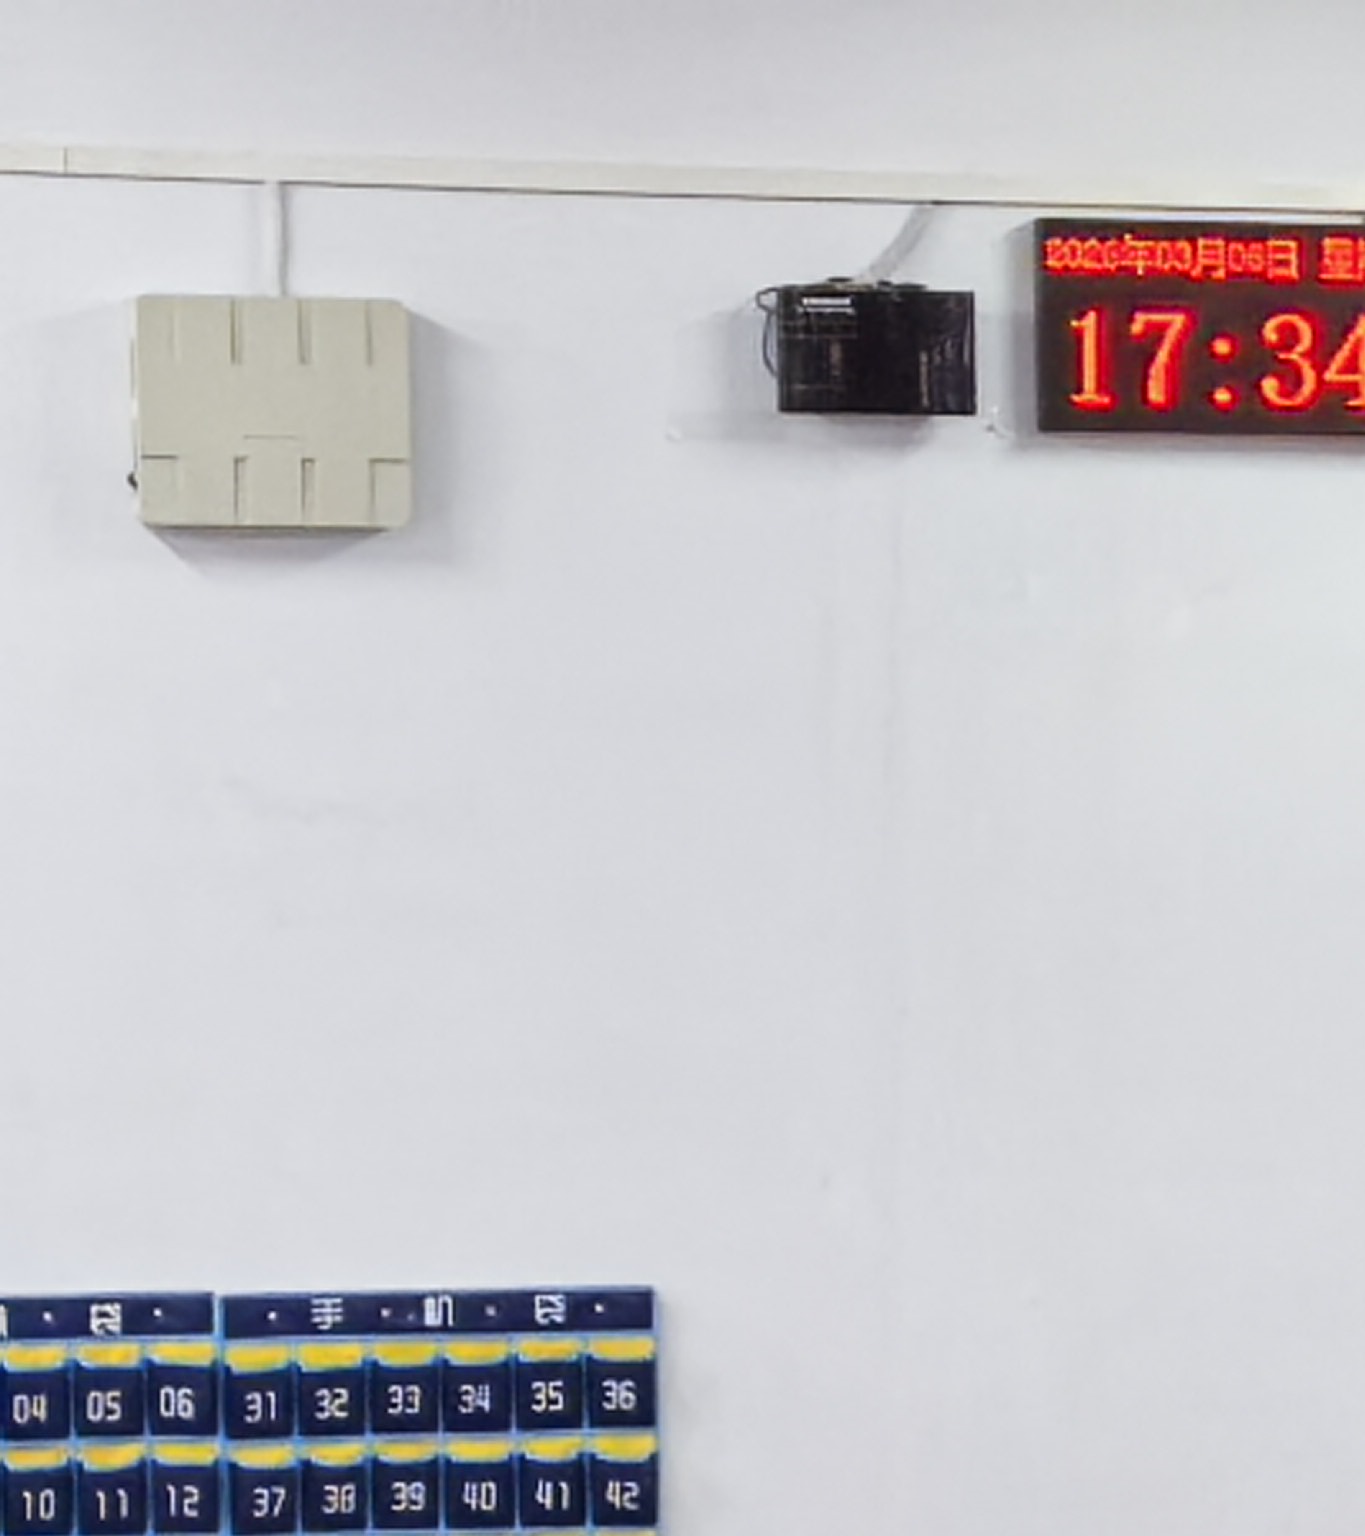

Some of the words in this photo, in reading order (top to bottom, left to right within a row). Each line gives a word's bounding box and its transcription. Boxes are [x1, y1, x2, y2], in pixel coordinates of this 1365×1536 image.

[12, 1394, 47, 1424] 04
[86, 1390, 122, 1422] 05
[159, 1385, 195, 1419] 06
[245, 1390, 276, 1423] 31
[315, 1387, 349, 1420] 32
[387, 1384, 421, 1415] 33
[458, 1384, 490, 1414] 34
[531, 1380, 564, 1413] 35
[602, 1379, 636, 1410] 36
[22, 1488, 55, 1520] 10
[96, 1488, 128, 1520] 11
[166, 1484, 200, 1518] 12
[253, 1486, 286, 1518] 37
[322, 1483, 356, 1514] 38
[391, 1481, 426, 1511] 39
[463, 1481, 497, 1511] 40
[535, 1479, 569, 1510] 41
[606, 1480, 640, 1510] 42
